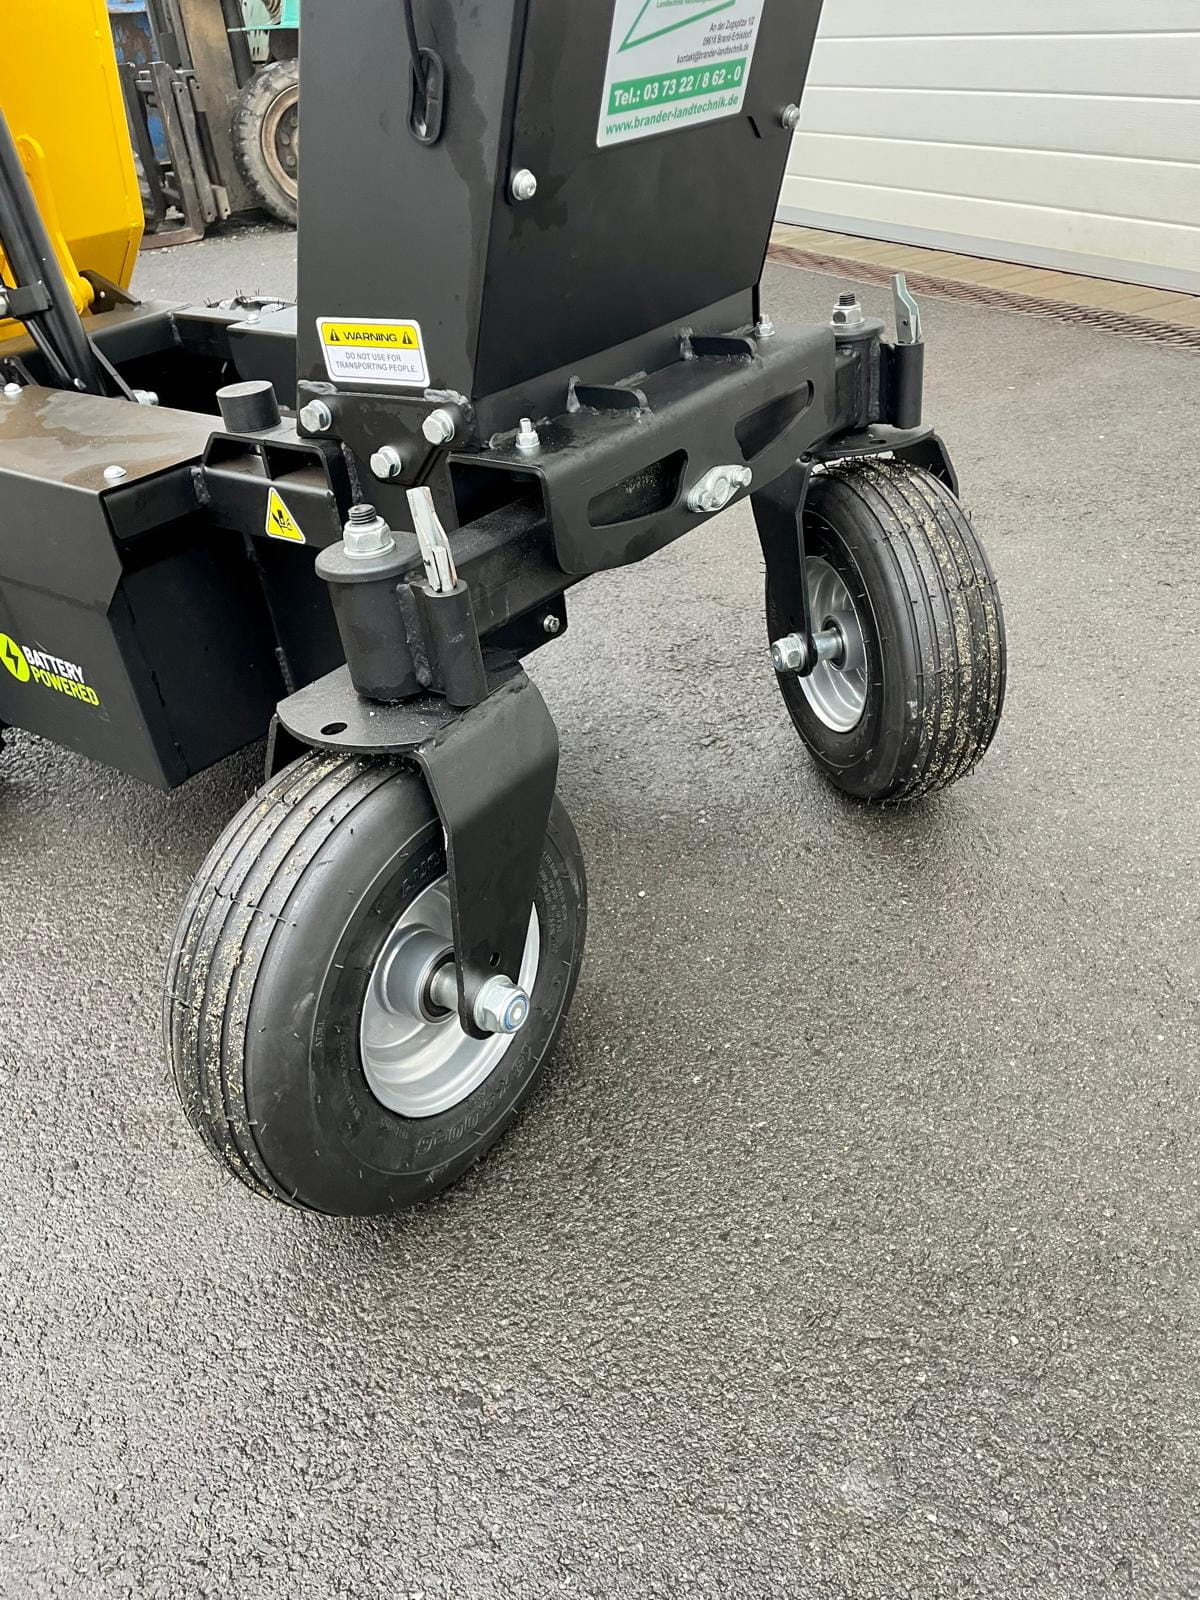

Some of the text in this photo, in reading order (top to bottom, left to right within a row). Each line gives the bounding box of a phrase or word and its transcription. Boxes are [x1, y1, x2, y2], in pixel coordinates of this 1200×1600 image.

[709, 22, 717, 32] An
[717, 21, 726, 30] der
[614, 89, 640, 107] Tel.:
[643, 82, 659, 100] 03
[662, 79, 677, 97] 73
[679, 75, 694, 93] 22
[695, 73, 701, 90] /
[701, 72, 710, 88] 8
[711, 69, 726, 86] 62
[734, 65, 741, 81] 0
[605, 93, 739, 135] www.brander-landtechnik.de
[343, 332, 398, 342] WARNING
[336, 361, 388, 371] TRANSPORTING
[345, 352, 401, 362] DO NOT USE FOR
[21, 645, 85, 684] BATTERY
[30, 665, 100, 706] POWERED
